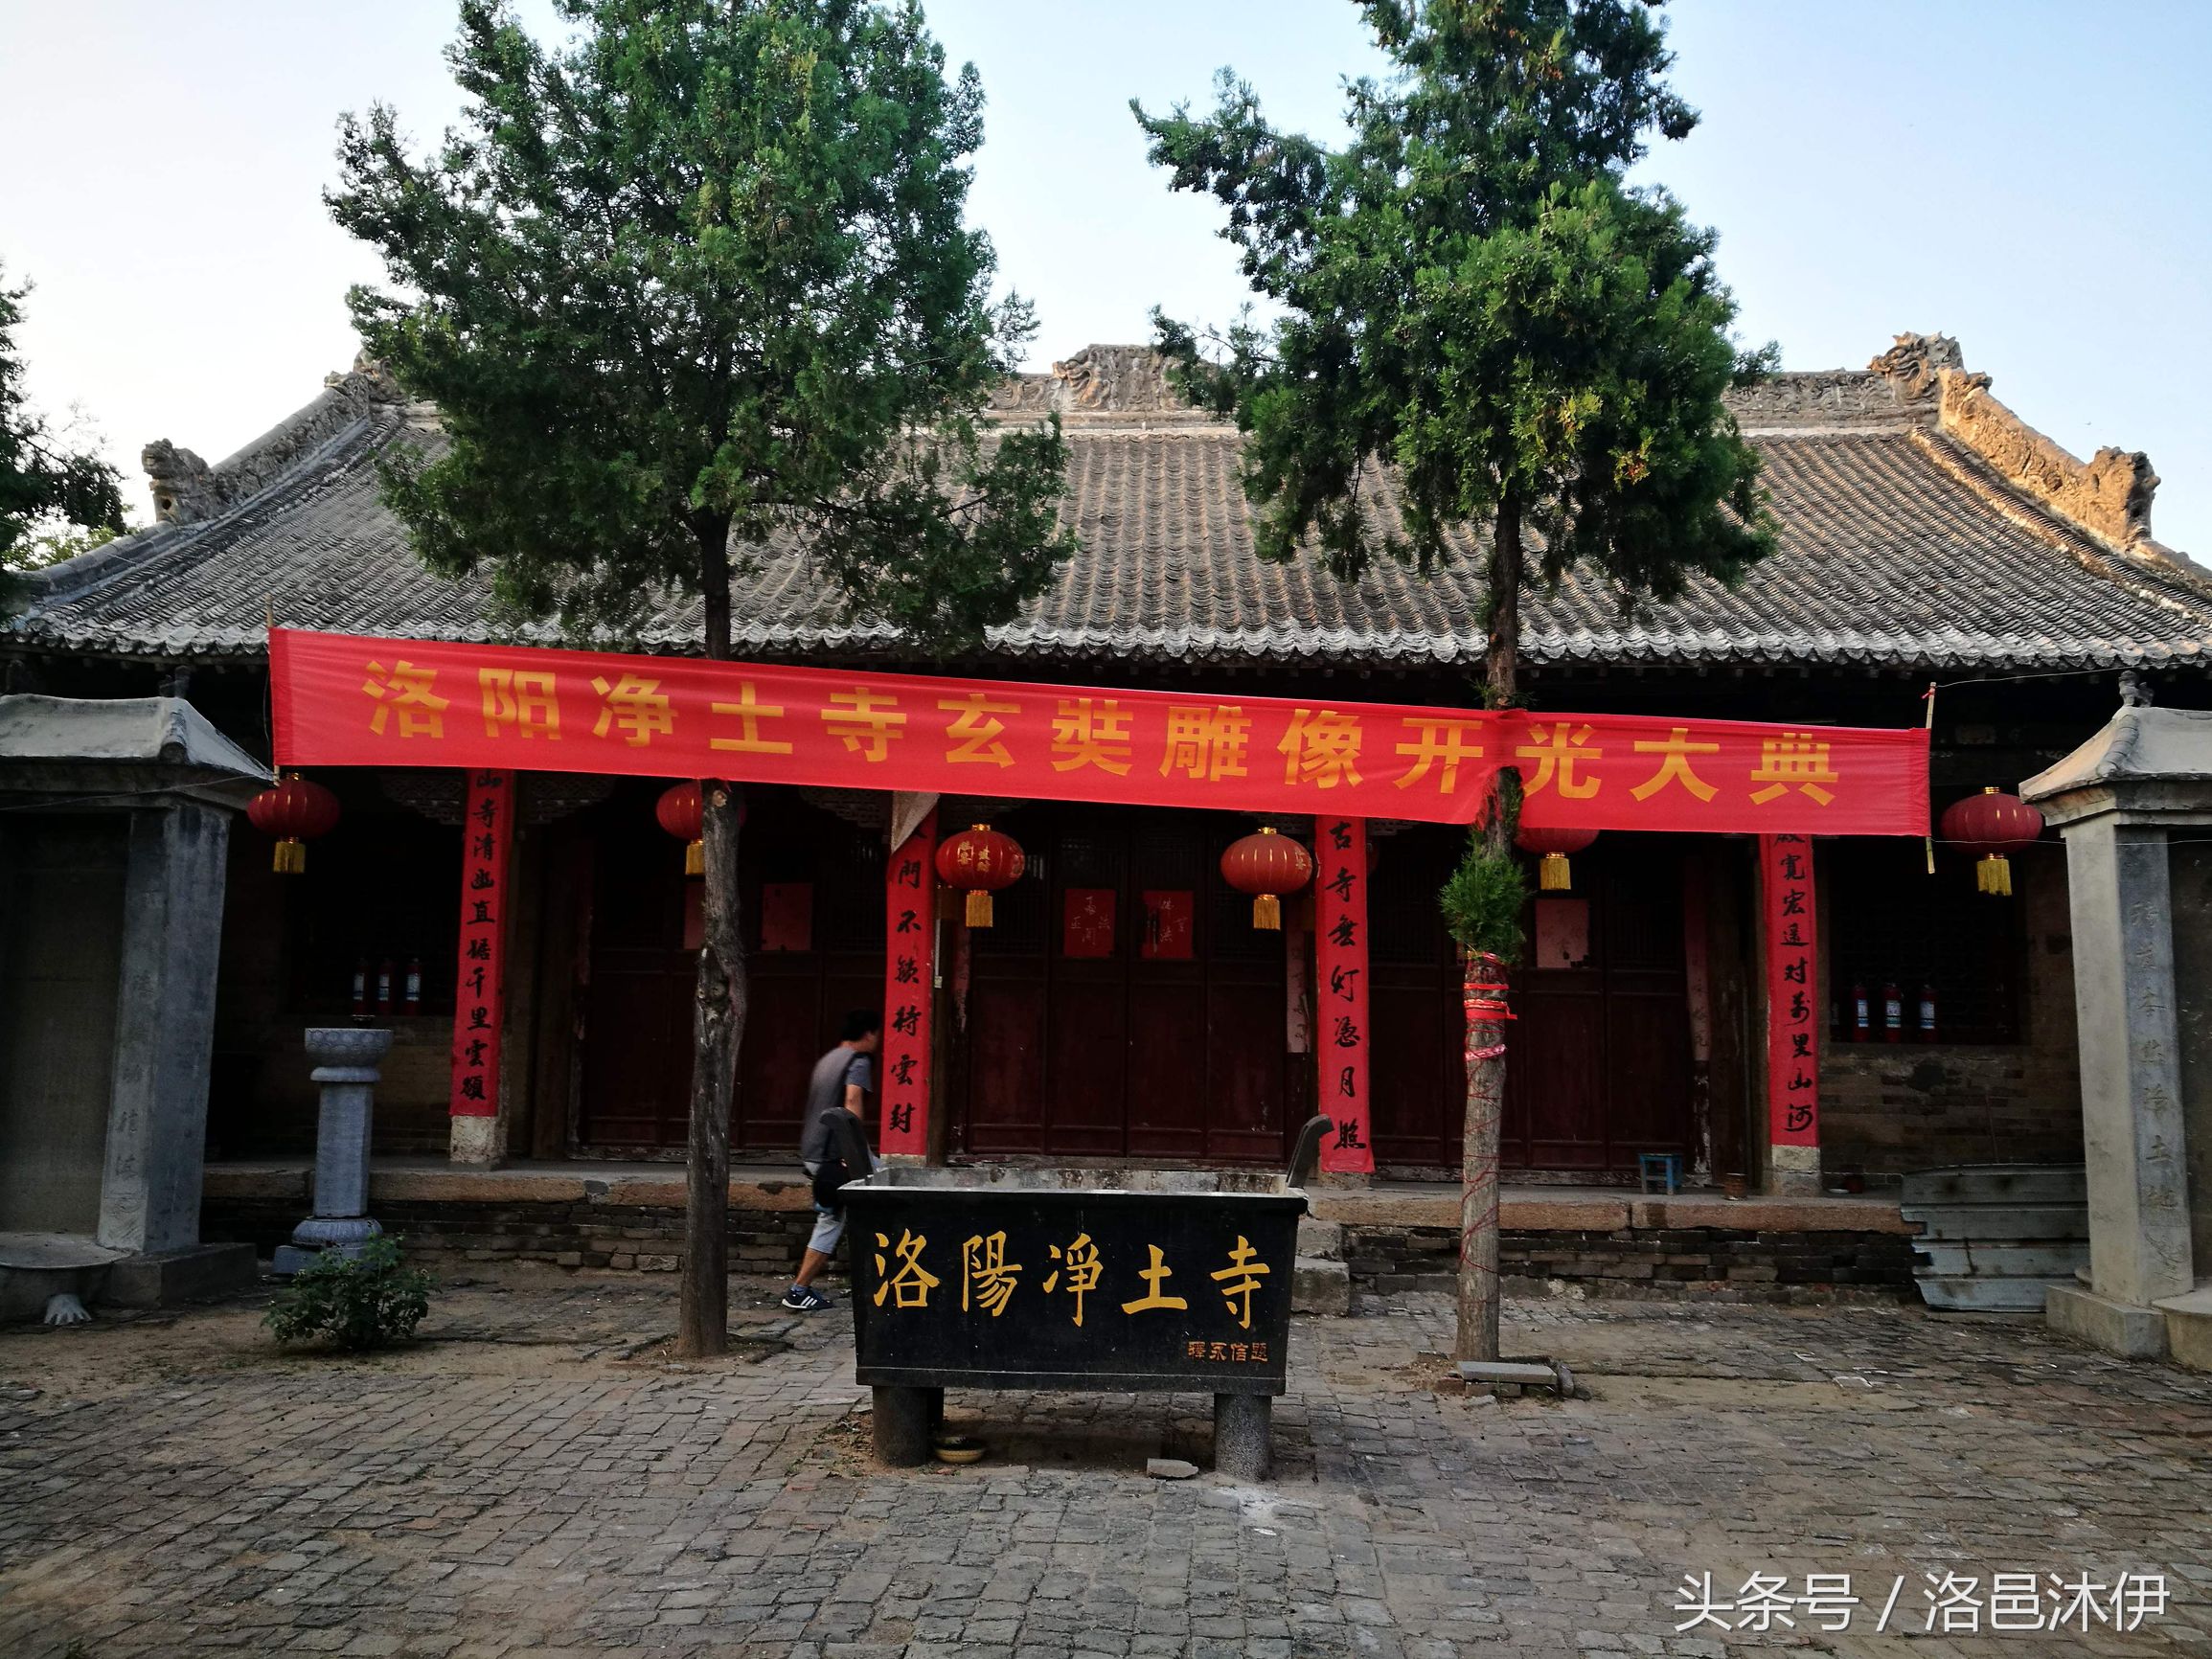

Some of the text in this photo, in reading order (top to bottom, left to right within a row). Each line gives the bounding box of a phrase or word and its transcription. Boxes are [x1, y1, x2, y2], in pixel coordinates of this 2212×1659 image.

[361, 659, 1839, 807] 洛阳净土寺玄奘雕像开光大典
